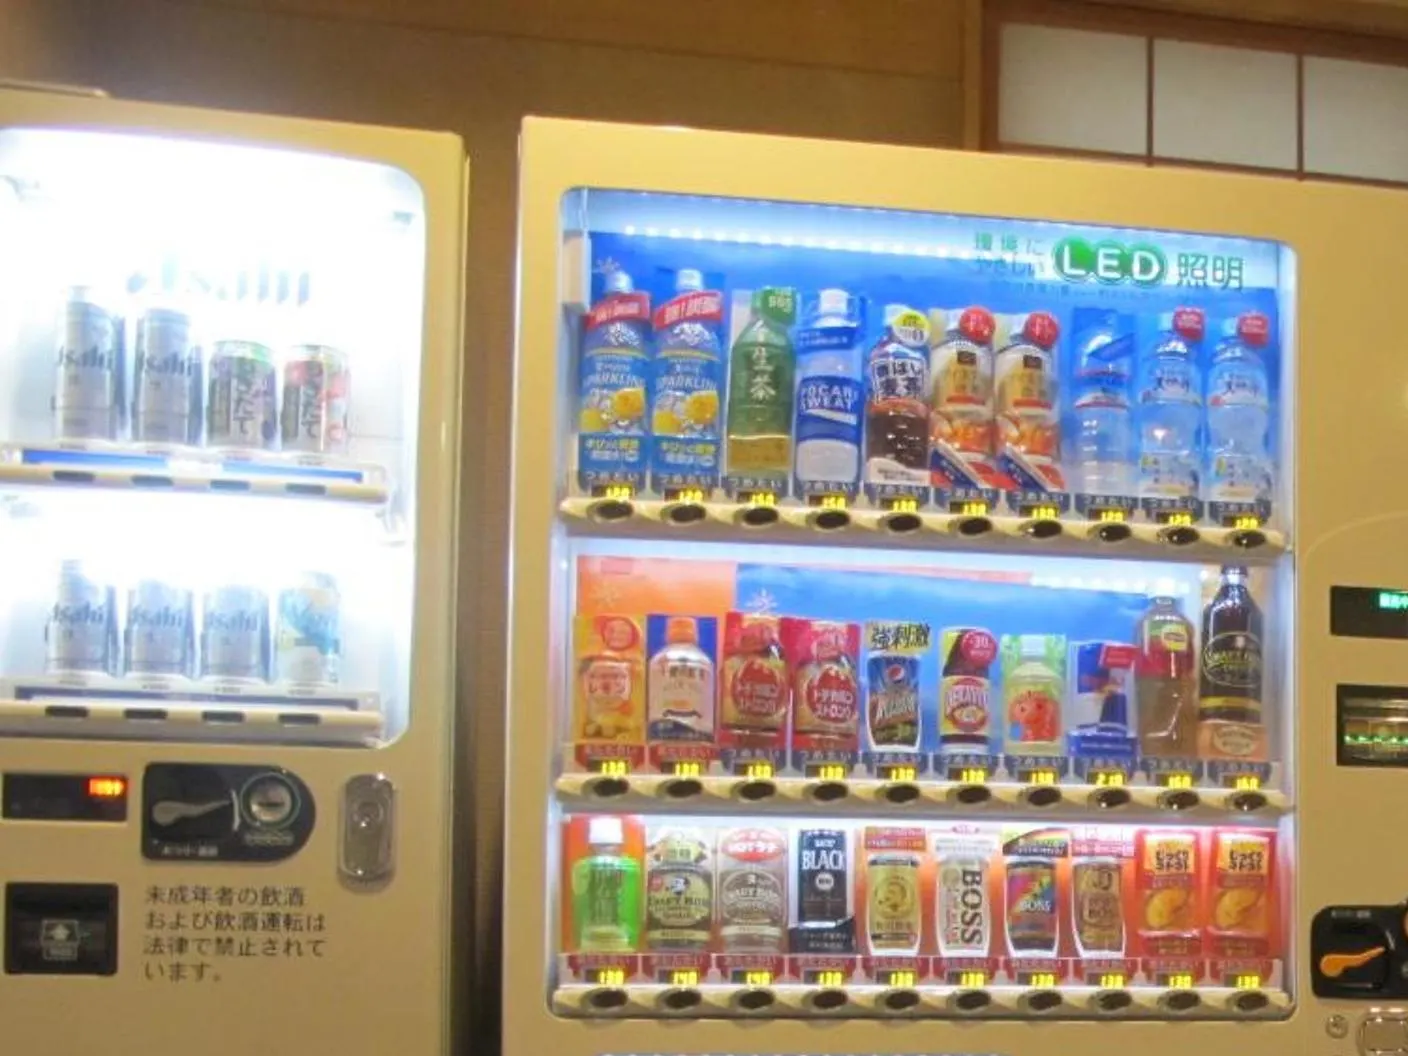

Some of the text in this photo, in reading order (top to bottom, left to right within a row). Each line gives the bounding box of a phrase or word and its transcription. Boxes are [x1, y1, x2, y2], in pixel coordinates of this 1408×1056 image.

[1063, 243, 1245, 291] LED 照明
[146, 886, 305, 907] 未成年者の飲酒
[962, 869, 983, 945] BOSS
[145, 912, 326, 933] および飲酒運転は
[143, 937, 327, 958] 法律で禁止されて
[144, 962, 223, 983] います。
